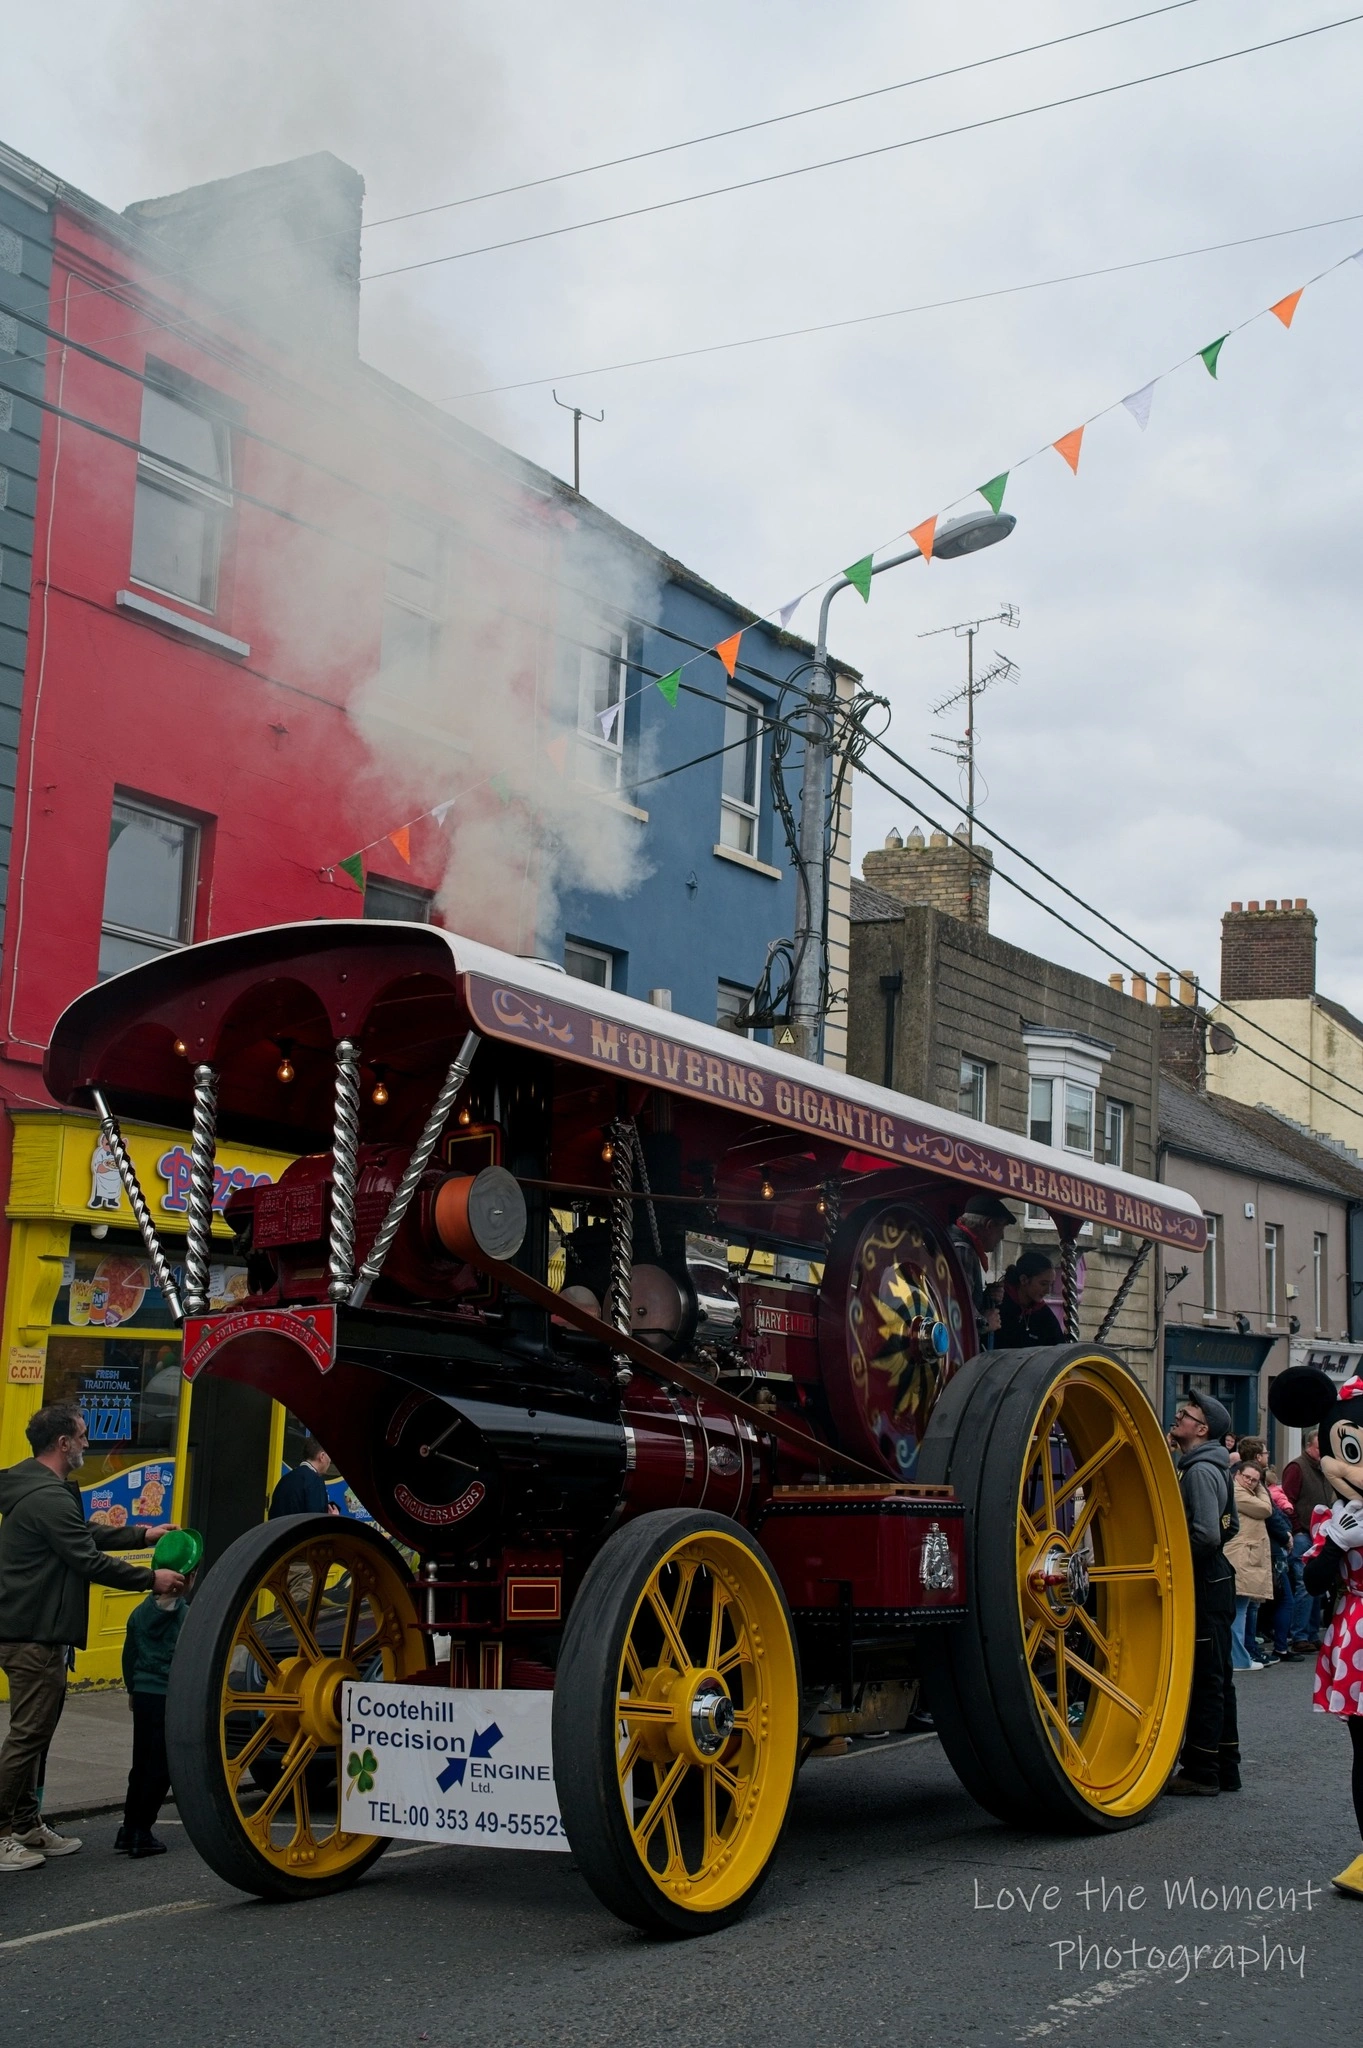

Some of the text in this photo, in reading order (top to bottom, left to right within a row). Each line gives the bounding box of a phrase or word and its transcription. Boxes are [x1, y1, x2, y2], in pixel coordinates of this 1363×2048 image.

[775, 1080, 895, 1148] GIGANTIC
[1006, 1159, 1107, 1215] PLEASURE
[1114, 1193, 1162, 1233] FAIRS
[758, 1309, 781, 1330] MARY
[192, 1341, 211, 1367] JOHN
[215, 1317, 248, 1342] FOWLER
[253, 1315, 260, 1325] &
[11, 1365, 43, 1379] C.C.T.V.
[96, 1369, 120, 1379] FRESH
[84, 1380, 131, 1390] TRADITIONAL
[91, 1498, 111, 1509] Deal
[92, 1489, 113, 1498] Double
[451, 1489, 479, 1516] LEEDS
[357, 1696, 453, 1722] Cootehill
[351, 1724, 465, 1752] Precision
[471, 1782, 494, 1794] Ltd.
[368, 1801, 429, 1827] TEL:00
[436, 1808, 468, 1831] 353
